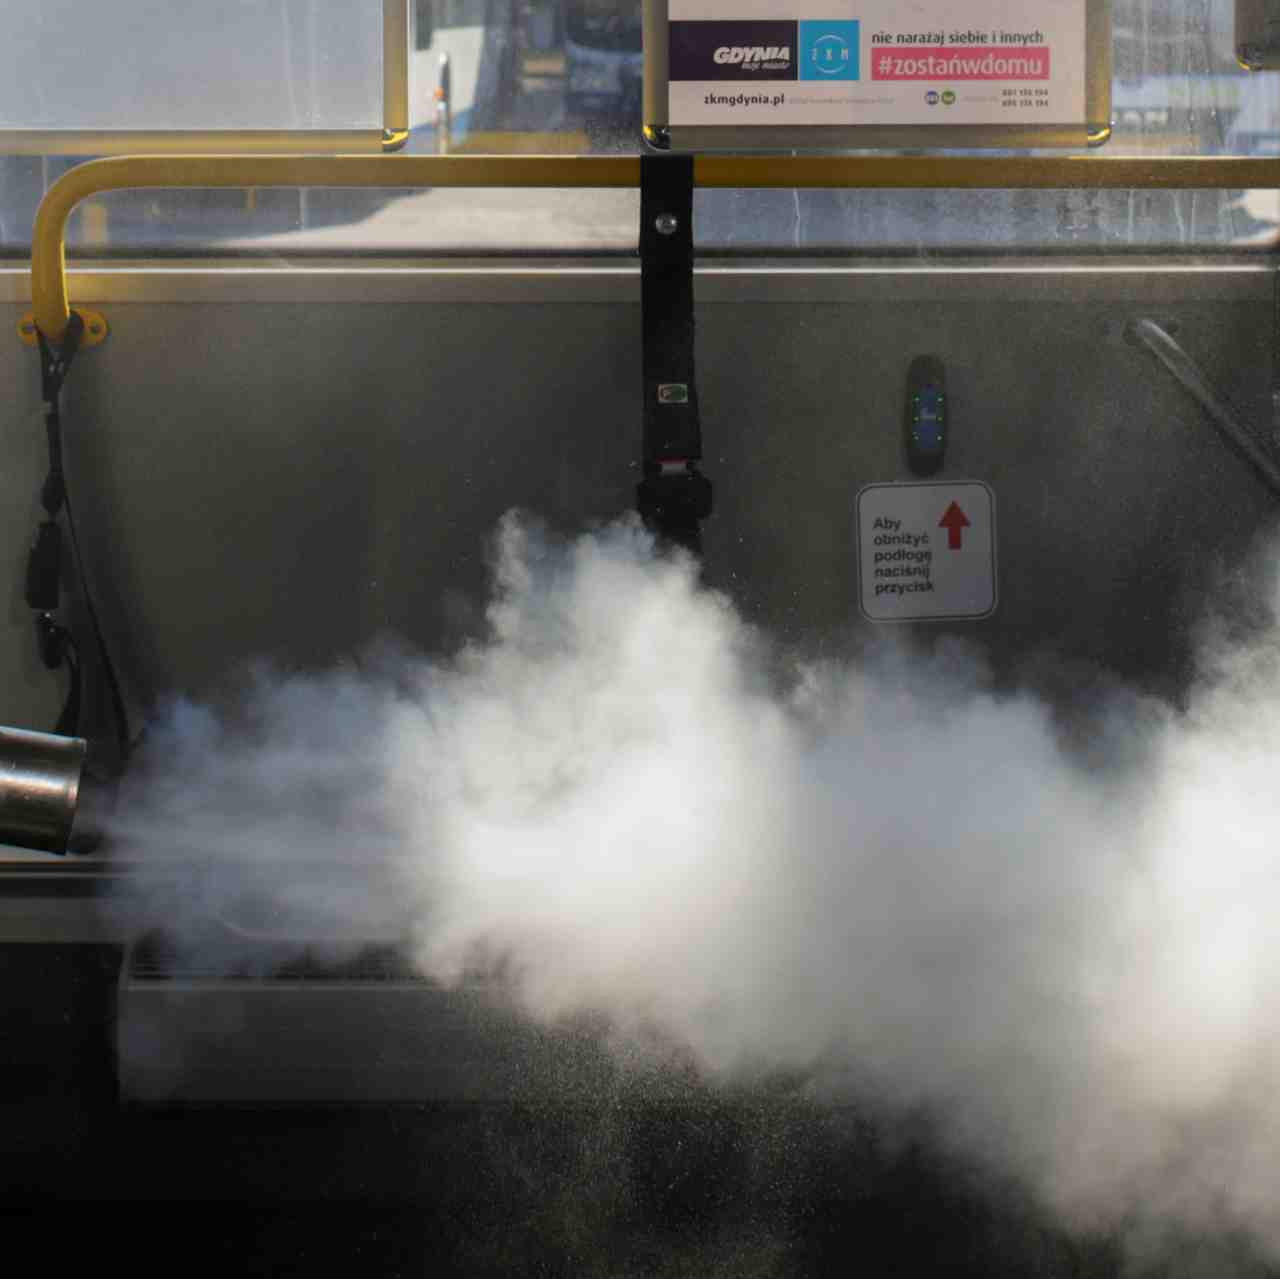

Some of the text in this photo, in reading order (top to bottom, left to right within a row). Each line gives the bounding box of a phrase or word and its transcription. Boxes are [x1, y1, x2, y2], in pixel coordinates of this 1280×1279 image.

[871, 32, 892, 43] nie
[896, 31, 945, 45] narażaj
[949, 30, 988, 43] siebie
[1000, 30, 1043, 46] innych
[713, 46, 790, 65] GDYNIA
[879, 53, 1042, 76] #zostańwdomu
[703, 93, 785, 107] zkmgdynia.pl
[873, 517, 901, 532] Aby
[874, 531, 929, 548] obniżyć
[874, 548, 933, 564] podłogę
[874, 565, 930, 580] naciśnij
[875, 581, 935, 596] przycisk
